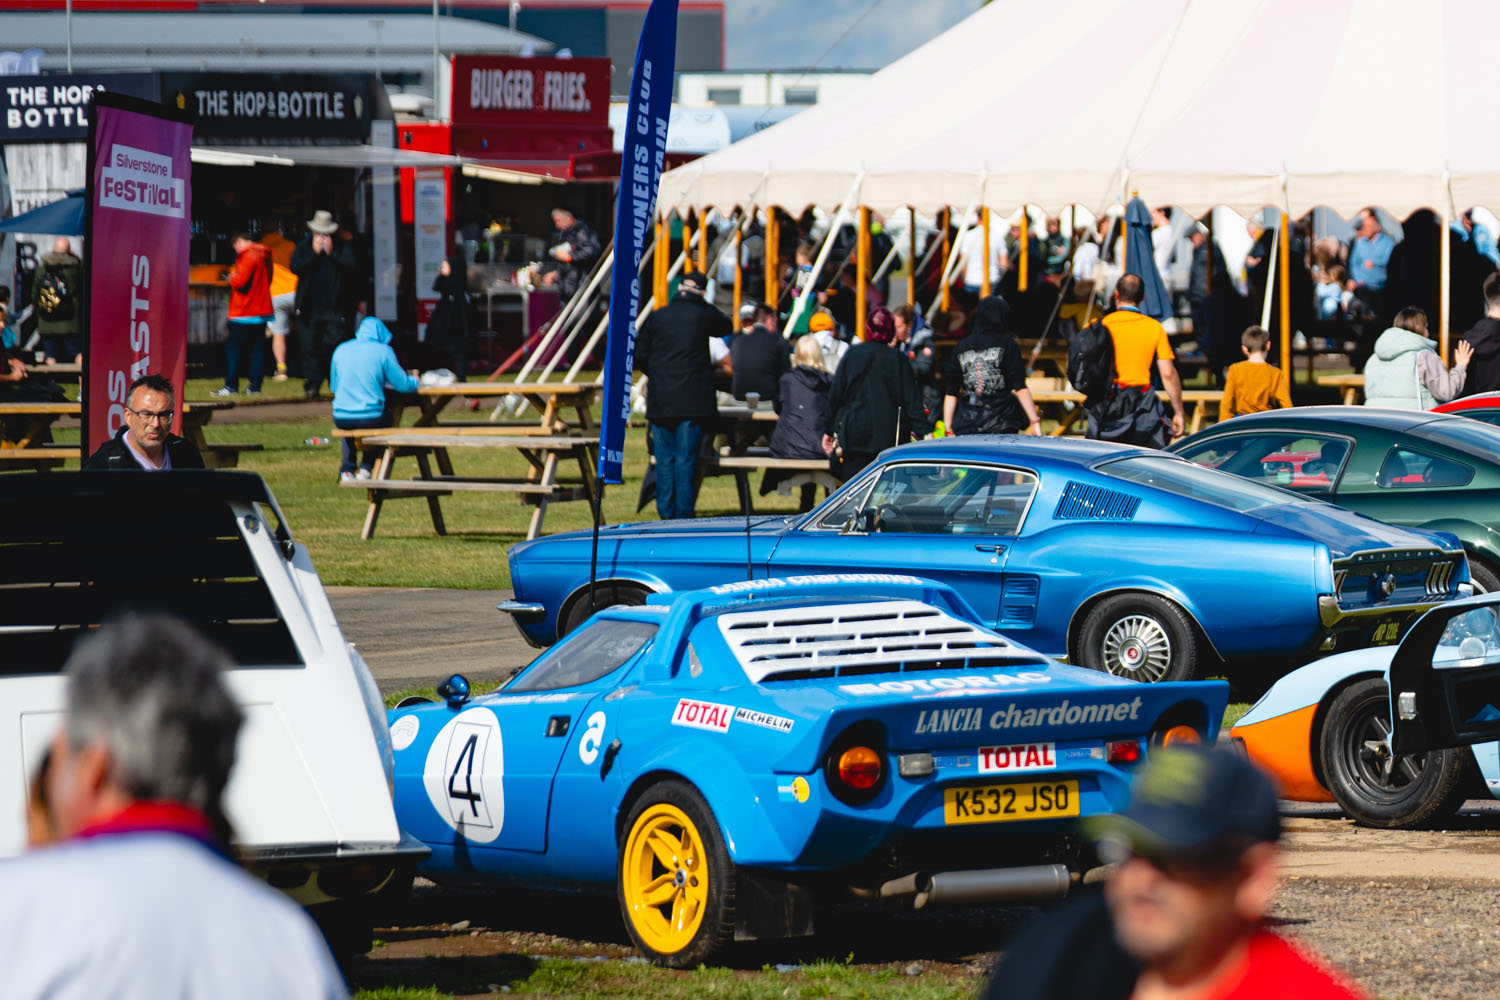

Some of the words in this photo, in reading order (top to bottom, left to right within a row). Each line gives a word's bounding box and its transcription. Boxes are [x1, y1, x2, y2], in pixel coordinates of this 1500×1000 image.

[7, 87, 48, 105] THE
[195, 90, 229, 117] THE
[233, 91, 266, 117] HOP
[277, 91, 344, 118] BOTTLE
[471, 68, 534, 109] BURGER
[544, 71, 591, 112] FRIES.
[637, 59, 652, 136] CLUB
[7, 107, 88, 128] BOTTL
[116, 153, 168, 177] Silverstone
[838, 672, 1052, 696] MOTORAC
[677, 701, 728, 728] TOTAL
[736, 709, 792, 729] MICHELIN
[915, 707, 983, 734] LANCIA
[989, 697, 1142, 730] chardonnet
[979, 744, 1054, 769] TOTAL
[448, 734, 482, 817] 4
[955, 788, 1016, 817] K532
[1024, 784, 1068, 812] JSO
